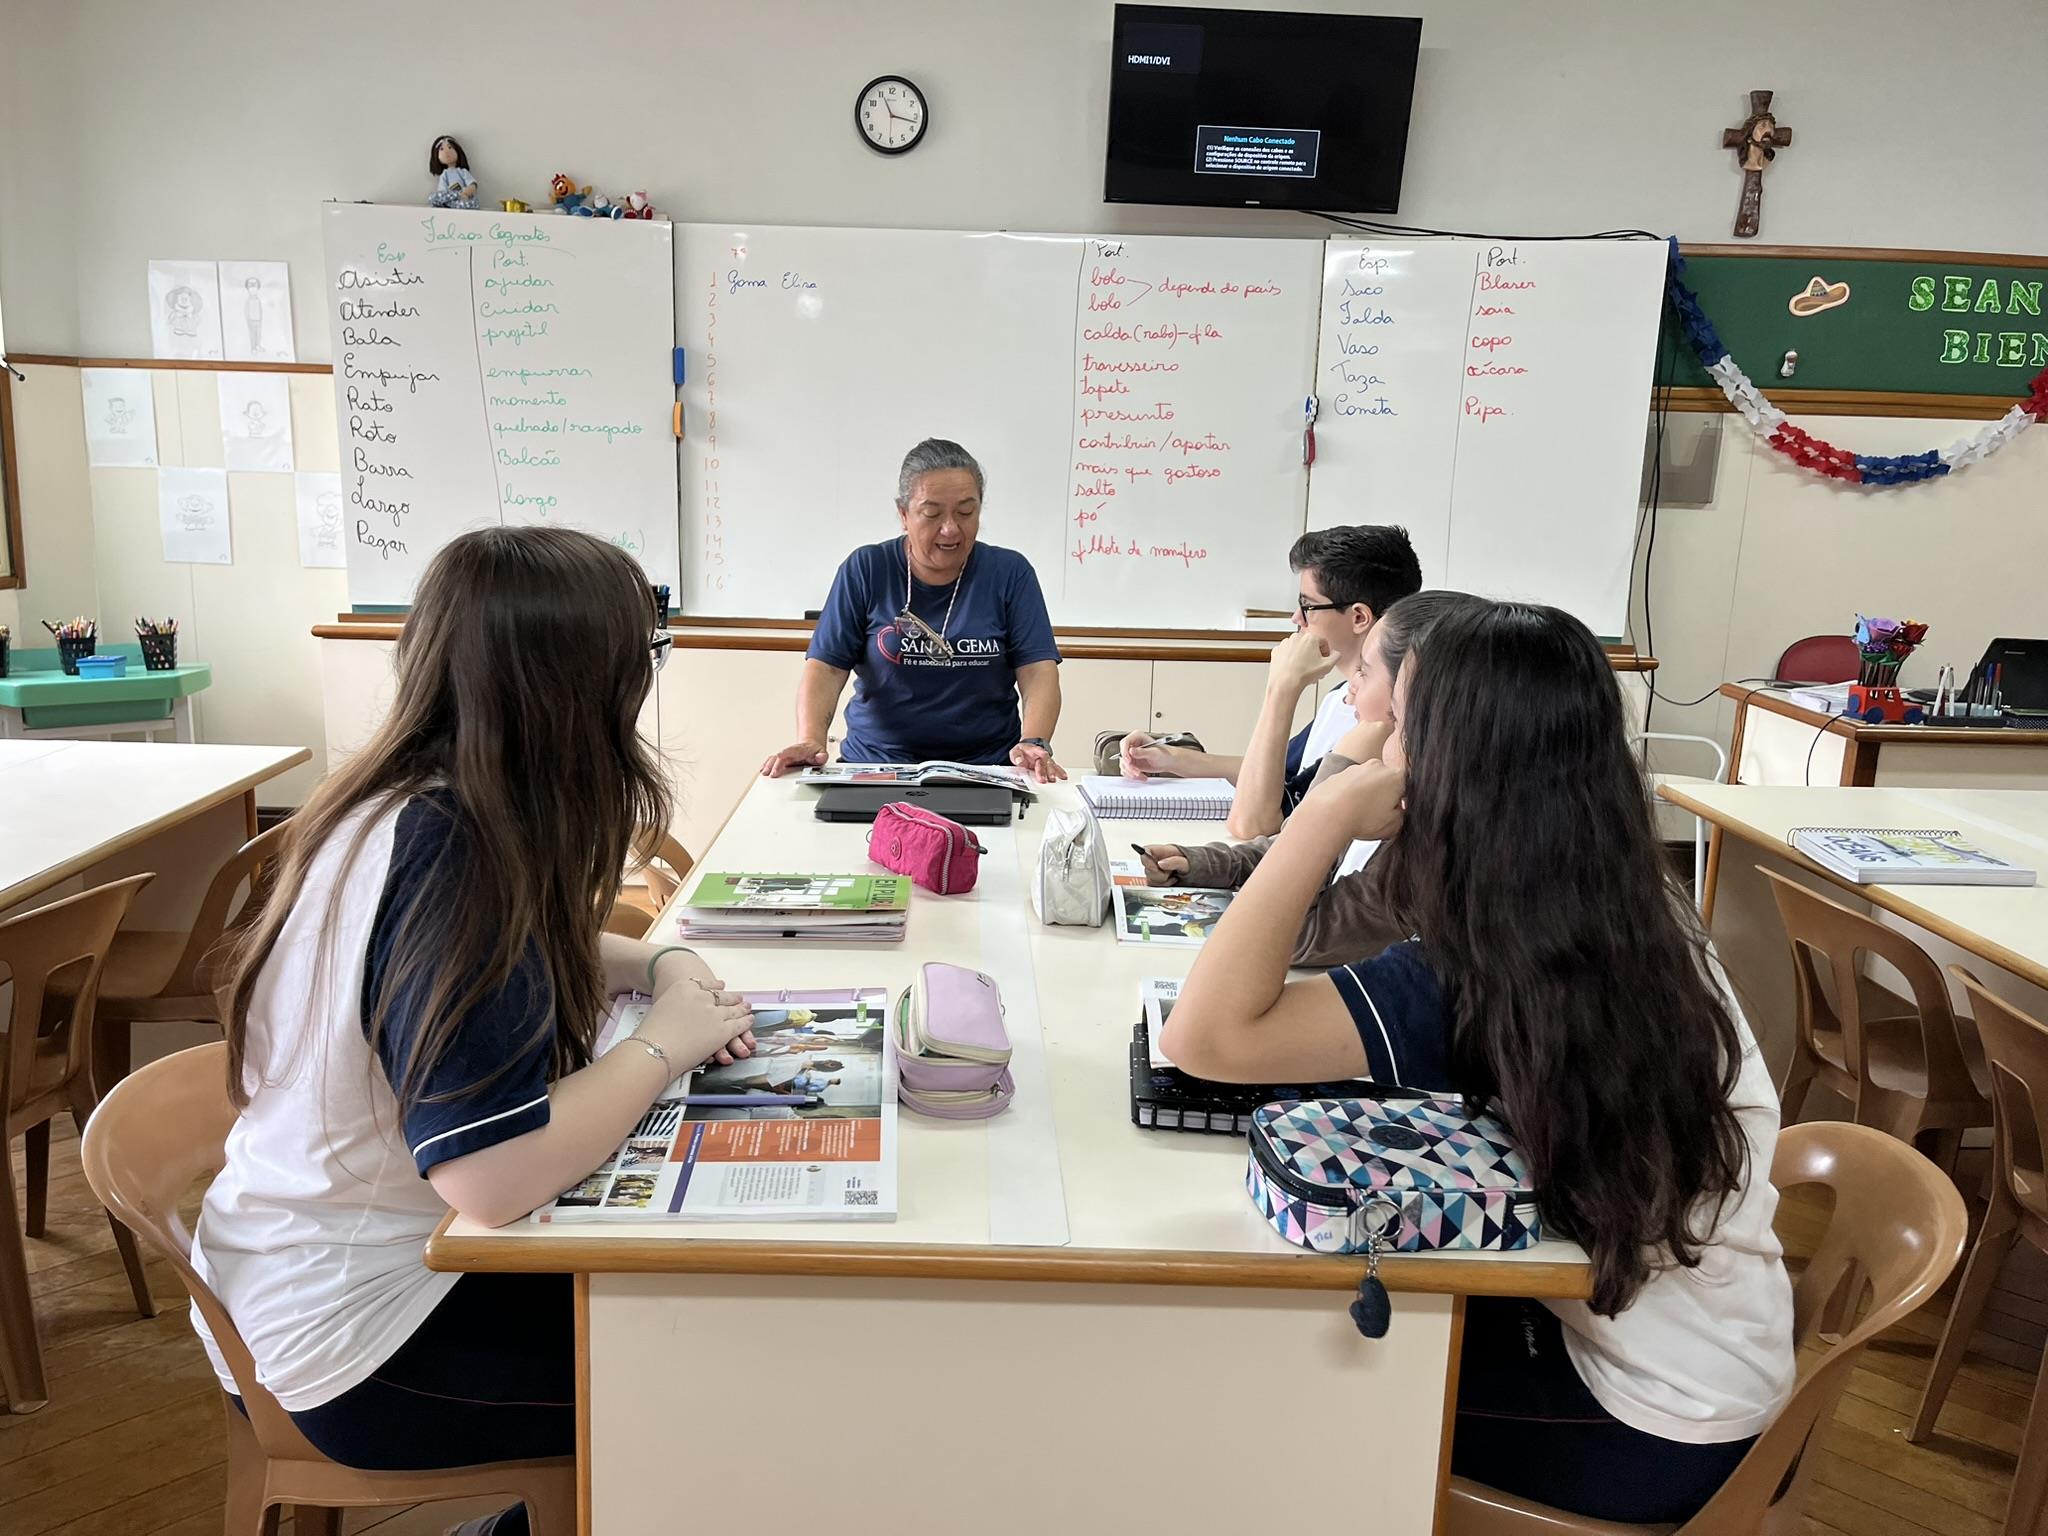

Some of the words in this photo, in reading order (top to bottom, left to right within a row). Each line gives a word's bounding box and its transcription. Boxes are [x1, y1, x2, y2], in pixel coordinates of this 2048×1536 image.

[1127, 54, 1171, 66] HDMI1/DVI
[878, 90, 884, 98] 11
[888, 87, 896, 95] 12
[1248, 136, 1264, 144] Cabo
[1264, 137, 1296, 145] Conectado
[421, 216, 483, 243] Falsos
[488, 223, 551, 248] Cognatos
[1090, 266, 1126, 287] bolo
[484, 275, 555, 297] ajudar
[1157, 277, 1216, 299] depende
[1220, 282, 1239, 294] do
[707, 292, 717, 307] 2
[1087, 293, 1122, 312] bolo
[1908, 275, 2043, 316] SEAN
[1338, 300, 1396, 325] Falda
[1475, 301, 1515, 316] saia
[707, 313, 717, 328] 3
[342, 326, 401, 347] Bala
[706, 331, 715, 347] 4
[1336, 333, 1379, 356] Vaso
[1471, 335, 1513, 352] copo
[706, 353, 717, 368] 5
[1083, 353, 1180, 372] travesseiro
[342, 352, 441, 393] Empujar
[486, 364, 593, 386] empurrar
[706, 372, 716, 387] 6
[1330, 359, 1386, 393] Taza
[1079, 375, 1131, 402] tapete
[346, 385, 393, 414] Rato
[490, 391, 568, 408] momento
[706, 391, 715, 406] 7
[1333, 393, 1399, 417] Cometa
[708, 411, 717, 429] 8
[1080, 402, 1176, 427] presunto
[349, 415, 398, 445] Roto
[707, 434, 717, 453] 9
[352, 446, 414, 480] Barra
[496, 448, 562, 466] Balcão
[704, 457, 720, 473] 10
[1075, 462, 1119, 476] mais
[1124, 467, 1153, 484] que
[1163, 463, 1222, 485] gostoso
[704, 479, 718, 494] 11
[1074, 479, 1117, 497] salto
[705, 496, 721, 509] 12
[705, 514, 722, 528] 13
[1073, 501, 1108, 528] pó
[356, 519, 409, 560] Pegar
[1127, 539, 1143, 556] de
[956, 638, 1000, 654] GEMA
[952, 660, 968, 668] para
